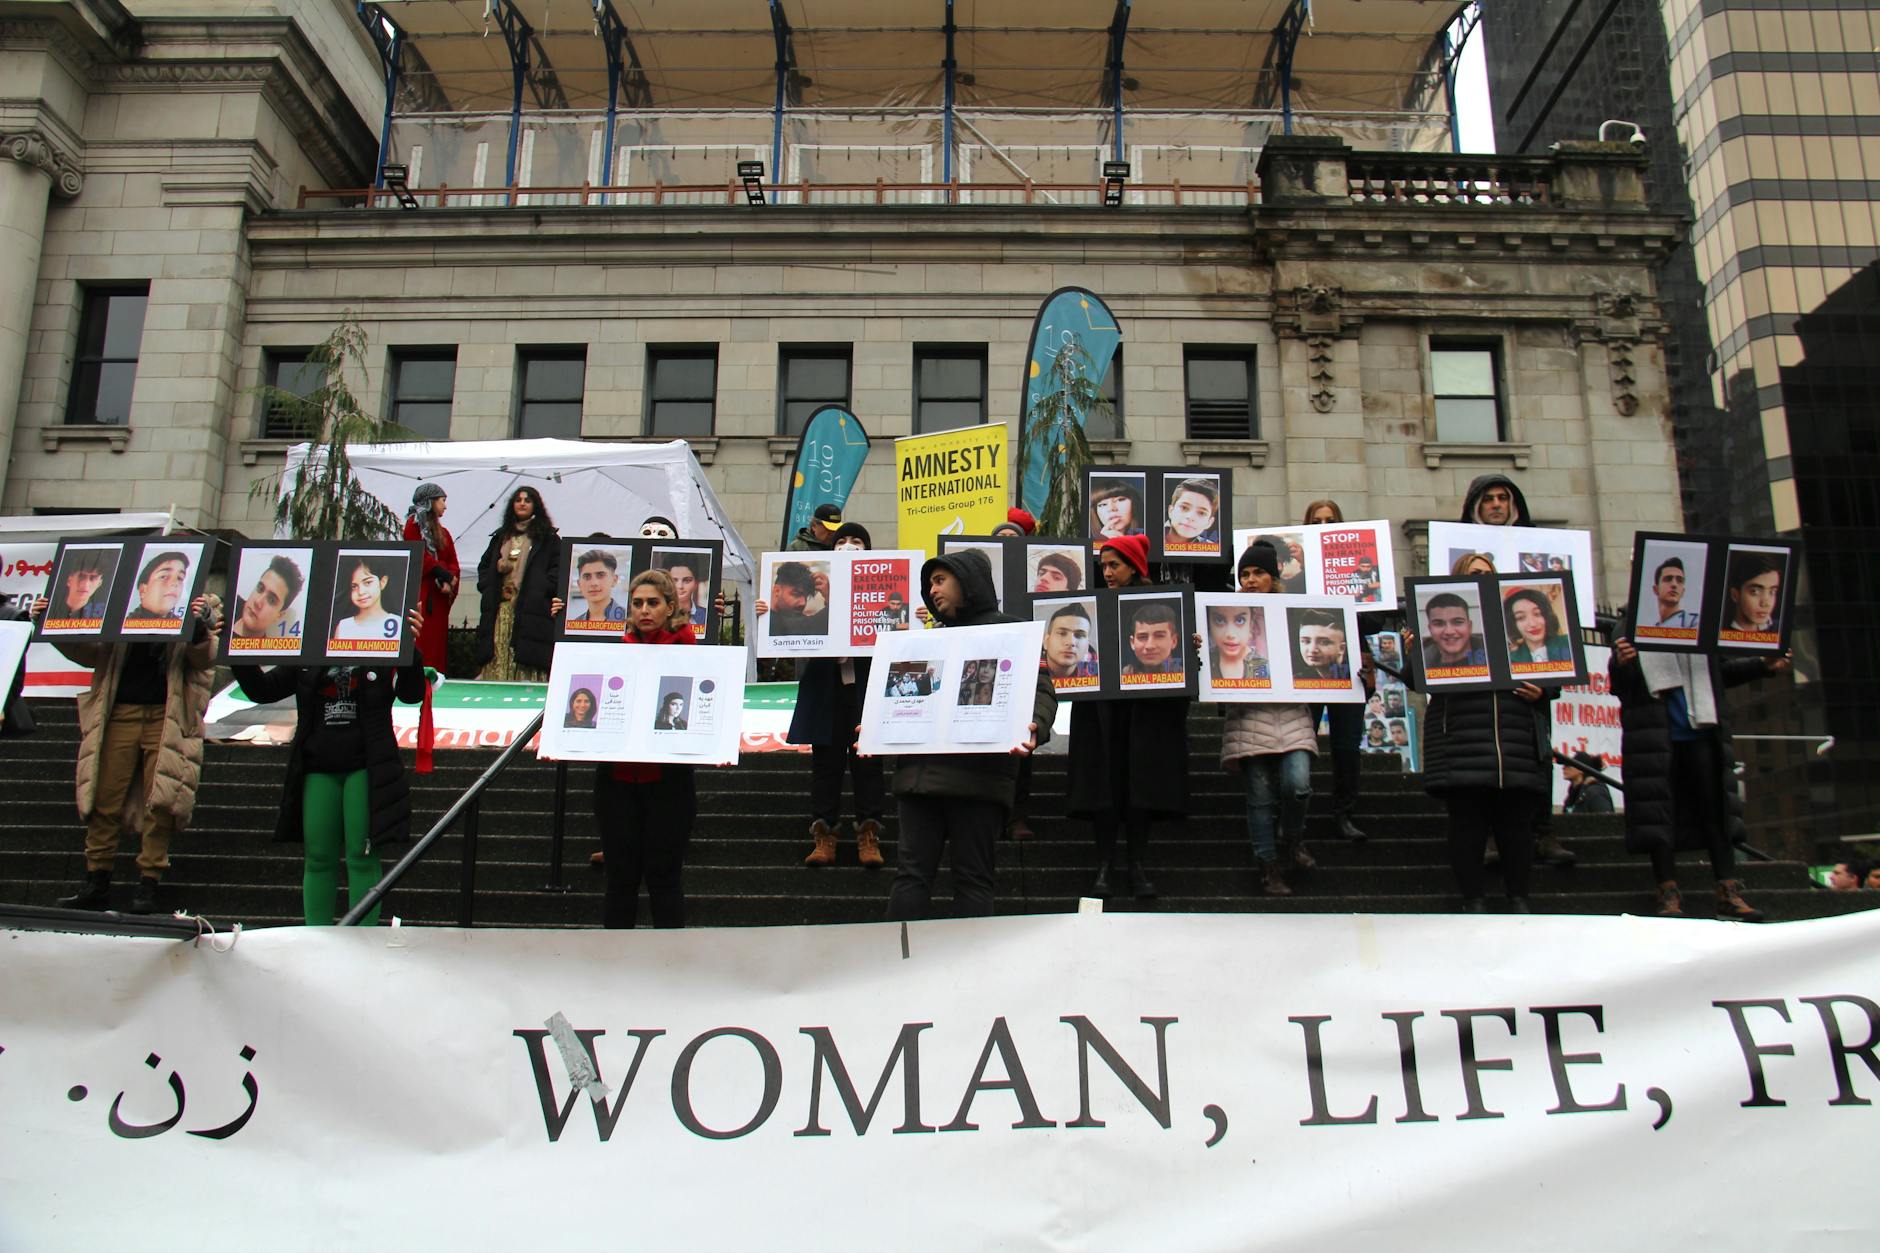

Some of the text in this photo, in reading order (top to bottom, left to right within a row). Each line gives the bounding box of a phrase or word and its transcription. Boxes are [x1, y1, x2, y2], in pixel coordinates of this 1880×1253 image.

[902, 444, 1000, 481] AMNESTY
[901, 474, 1001, 502] INTERNATIONAL
[907, 496, 994, 516] Tri-Cities Group 176
[1323, 533, 1360, 544] STOP!
[1165, 543, 1219, 552] SODIS KESHANI
[1324, 557, 1356, 568] FREE
[854, 563, 893, 575] STOP!
[1326, 584, 1364, 596] NOW!
[853, 592, 886, 603] FREE
[45, 619, 70, 629] EHSAN
[1678, 610, 1699, 627] 17
[278, 620, 301, 637] 14
[384, 618, 399, 638] 9
[853, 624, 891, 636] NOW!
[231, 638, 260, 649] SEPEHR
[329, 641, 399, 651] DIANA MAHMOUDI
[773, 638, 824, 646] Saman Yasin
[1063, 677, 1099, 688] KAZEMI
[1121, 674, 1151, 684] DANYAL
[1212, 679, 1237, 688] MONA
[1556, 702, 1574, 725] IN
[513, 994, 1880, 1149] WOMAN, LIFE, FR
[108, 1045, 259, 1140] زن
